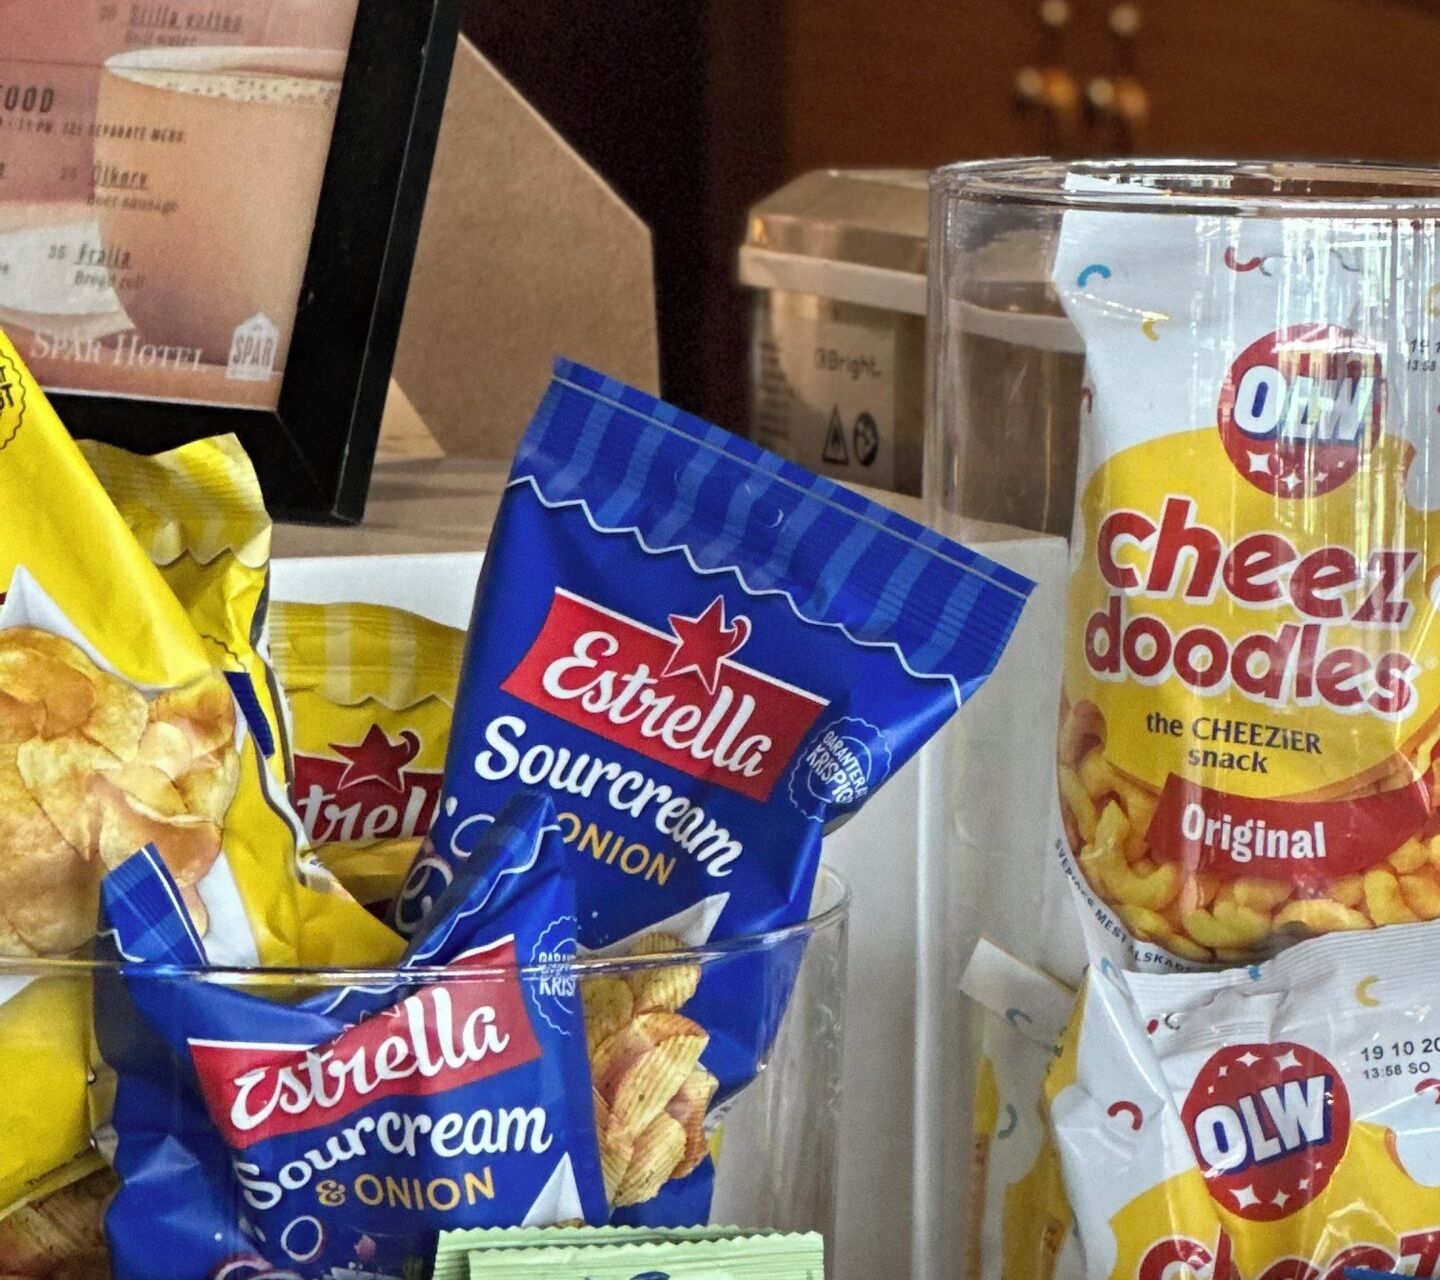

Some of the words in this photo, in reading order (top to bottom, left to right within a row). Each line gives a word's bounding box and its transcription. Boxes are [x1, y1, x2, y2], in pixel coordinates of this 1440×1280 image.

[31, 327, 98, 361] SPAR
[232, 337, 273, 367] SPAR
[1232, 362, 1380, 443] OLW
[1096, 494, 1424, 628] cheez
[1083, 596, 1420, 721] doodles
[541, 629, 774, 780] Estrella
[1146, 709, 1184, 738] the
[1191, 715, 1322, 756] CHEEZIER
[805, 744, 855, 805] KRISPIG
[822, 730, 869, 800] GARANTERA
[1187, 747, 1268, 775] snack
[299, 785, 441, 849] trell
[474, 714, 745, 879] Sourcream
[555, 811, 677, 887] ONION
[1180, 803, 1328, 862] Original
[539, 975, 577, 998] KRIS
[229, 986, 510, 1134] Estrella
[1361, 1044, 1386, 1063] 19
[1390, 1041, 1416, 1059] 10
[1362, 1063, 1404, 1081] 13:58
[1407, 1059, 1432, 1077] SO
[235, 1104, 554, 1212] Sourcream
[1191, 1075, 1335, 1178] OLW
[313, 1179, 346, 1207] &
[353, 1166, 496, 1213] ONION
